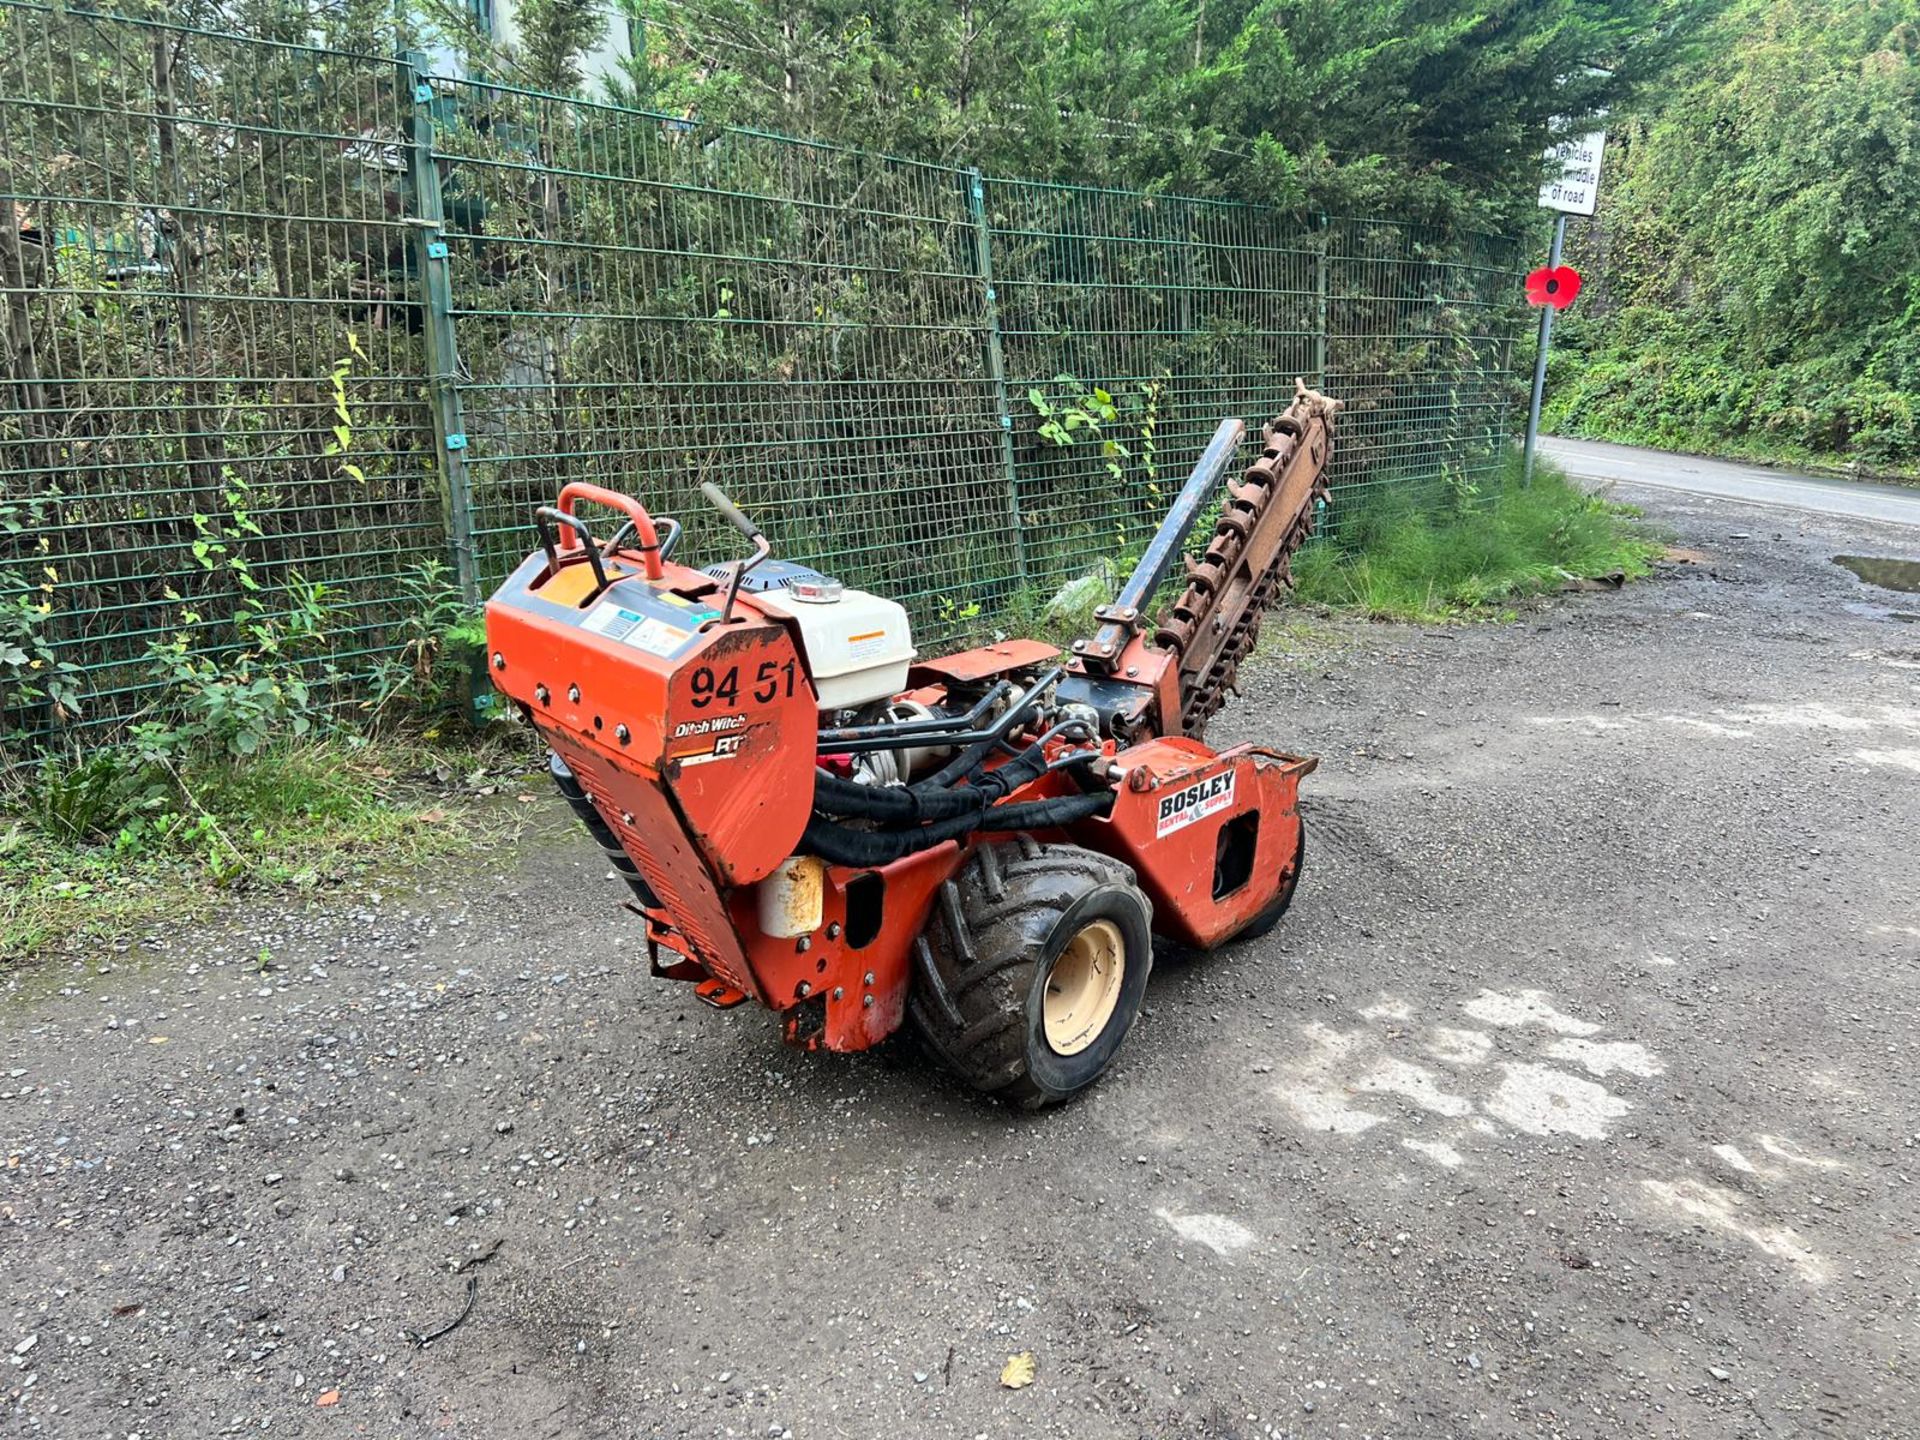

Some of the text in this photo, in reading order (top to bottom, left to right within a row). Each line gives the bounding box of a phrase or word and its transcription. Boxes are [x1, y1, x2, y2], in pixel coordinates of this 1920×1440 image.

[1552, 184, 1585, 204] of road
[690, 665, 740, 709] 94
[674, 713, 748, 739] Ditch Witch
[1159, 810, 1188, 830] RENTAL
[1205, 790, 1233, 810] SUPPLY
[1160, 770, 1235, 820] BOSLEY
